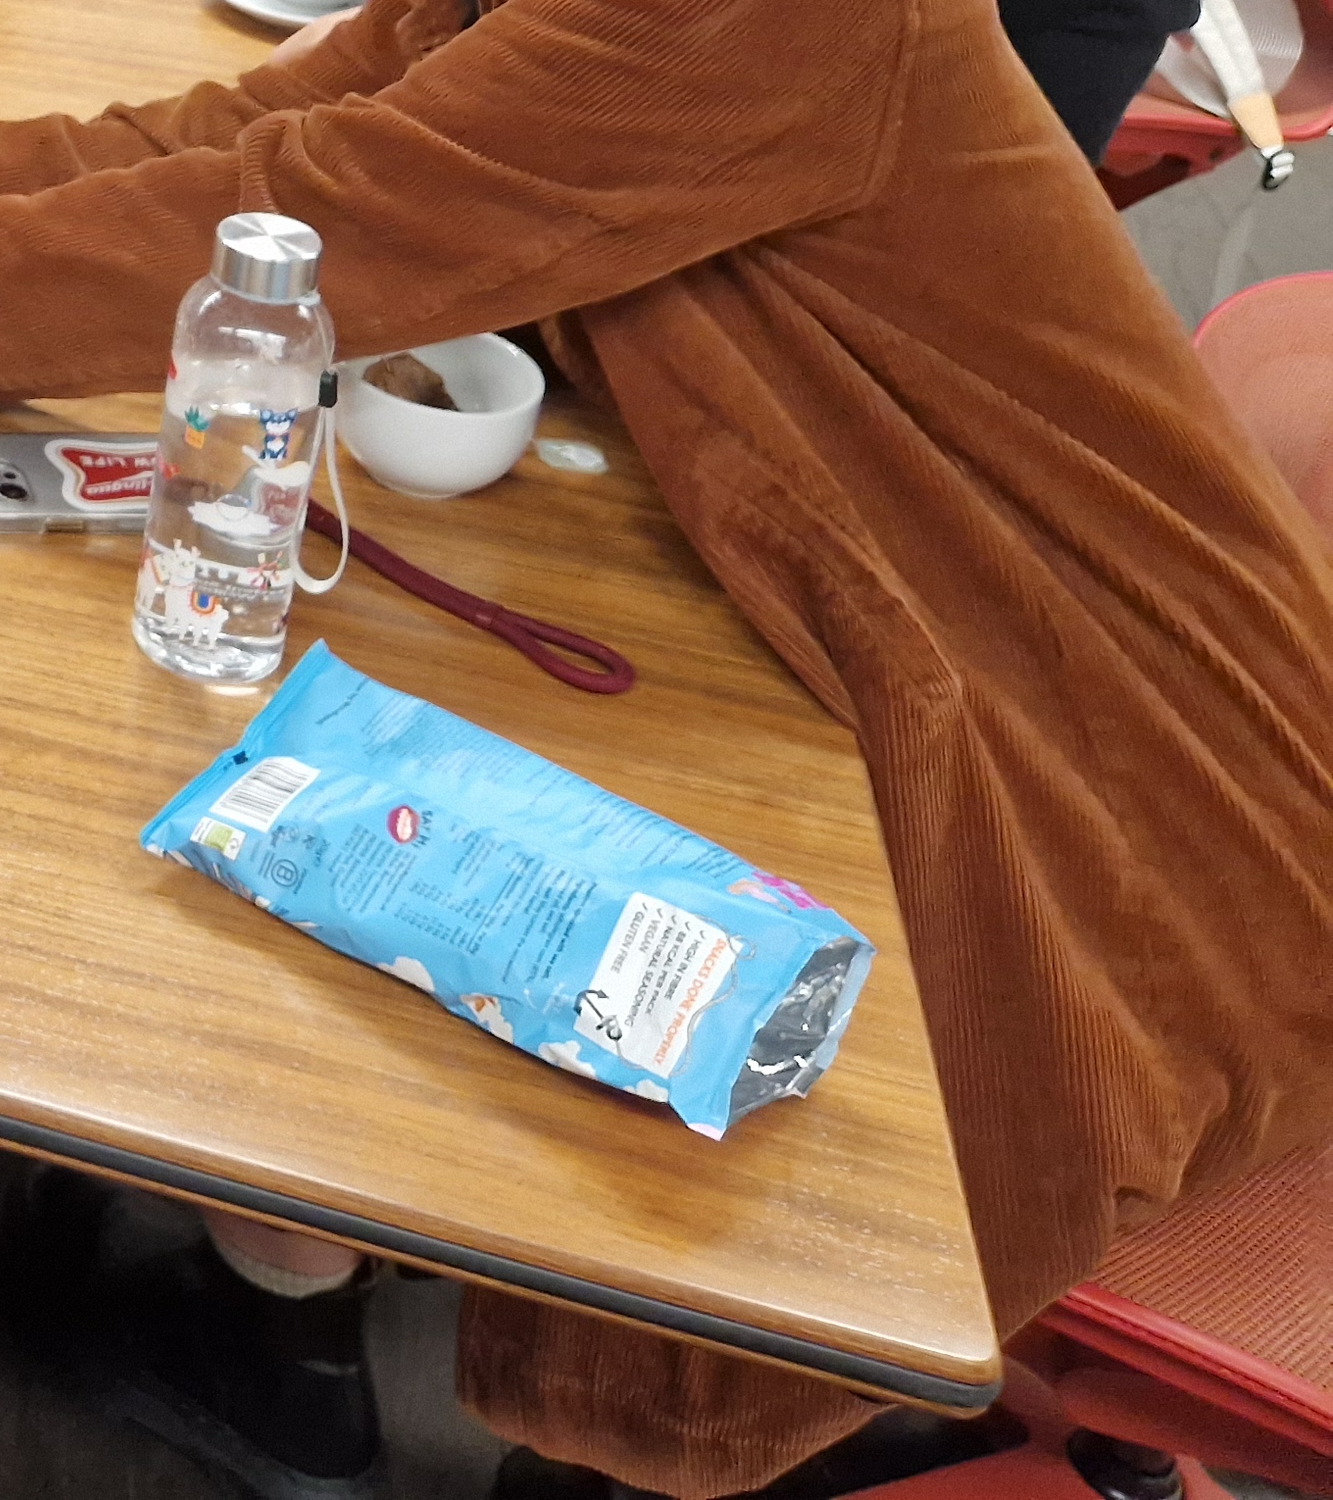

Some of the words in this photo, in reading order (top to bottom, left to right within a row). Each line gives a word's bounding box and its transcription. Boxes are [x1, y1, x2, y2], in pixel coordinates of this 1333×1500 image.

[78, 455, 127, 469] LIFE
[621, 910, 645, 948] GLUTEN
[638, 919, 661, 954] VEGAN
[648, 925, 674, 968] NATURAL
[663, 941, 681, 968] KCAL
[684, 939, 701, 963] HIGH
[698, 938, 728, 980] SNACKS
[610, 947, 629, 975] FREE
[677, 962, 689, 975] IN
[655, 969, 668, 989] PER
[664, 973, 682, 1001] FIBRE
[624, 970, 654, 1028] SEASONING
[645, 989, 660, 1016] PACK
[679, 979, 705, 1012] DONE
